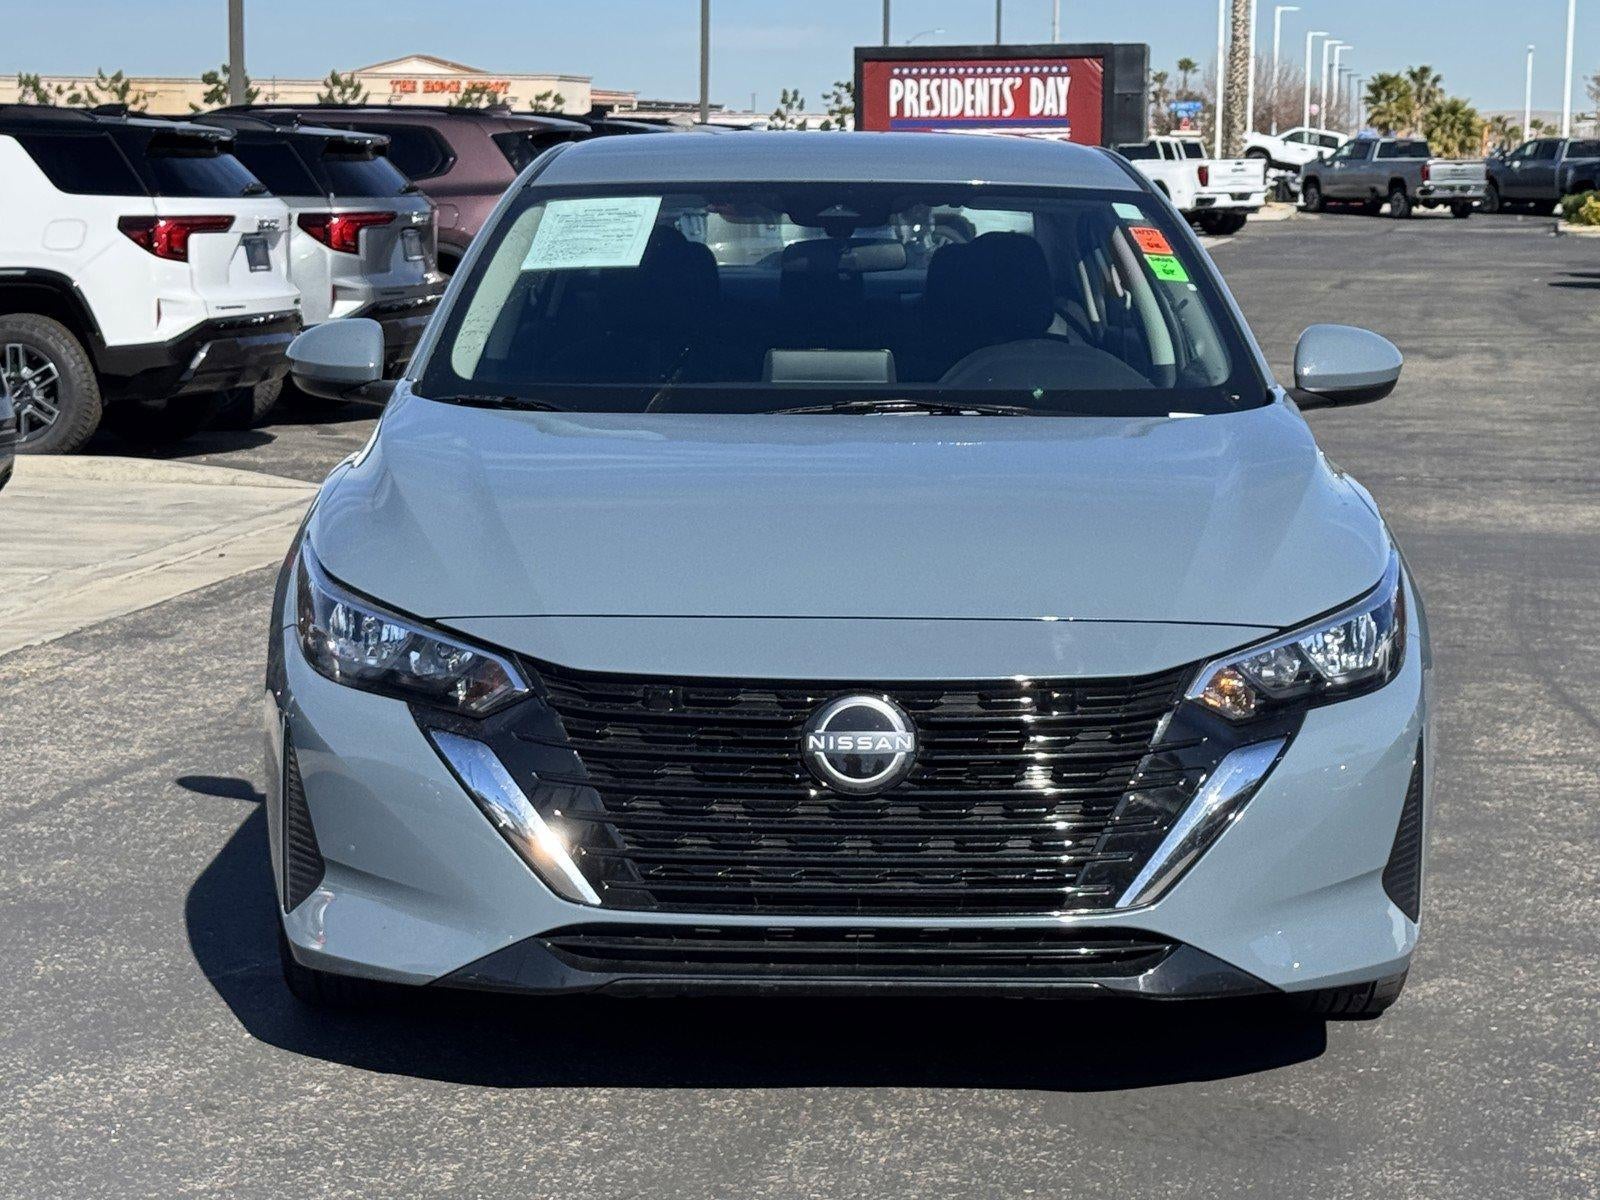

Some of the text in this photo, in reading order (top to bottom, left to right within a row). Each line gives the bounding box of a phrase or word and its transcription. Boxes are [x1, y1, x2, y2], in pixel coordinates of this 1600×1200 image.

[390, 80, 417, 93] THE
[423, 80, 460, 93] HOME
[889, 76, 1071, 118] PRESIDENTS’ DAY
[808, 735, 912, 750] NISSAN
